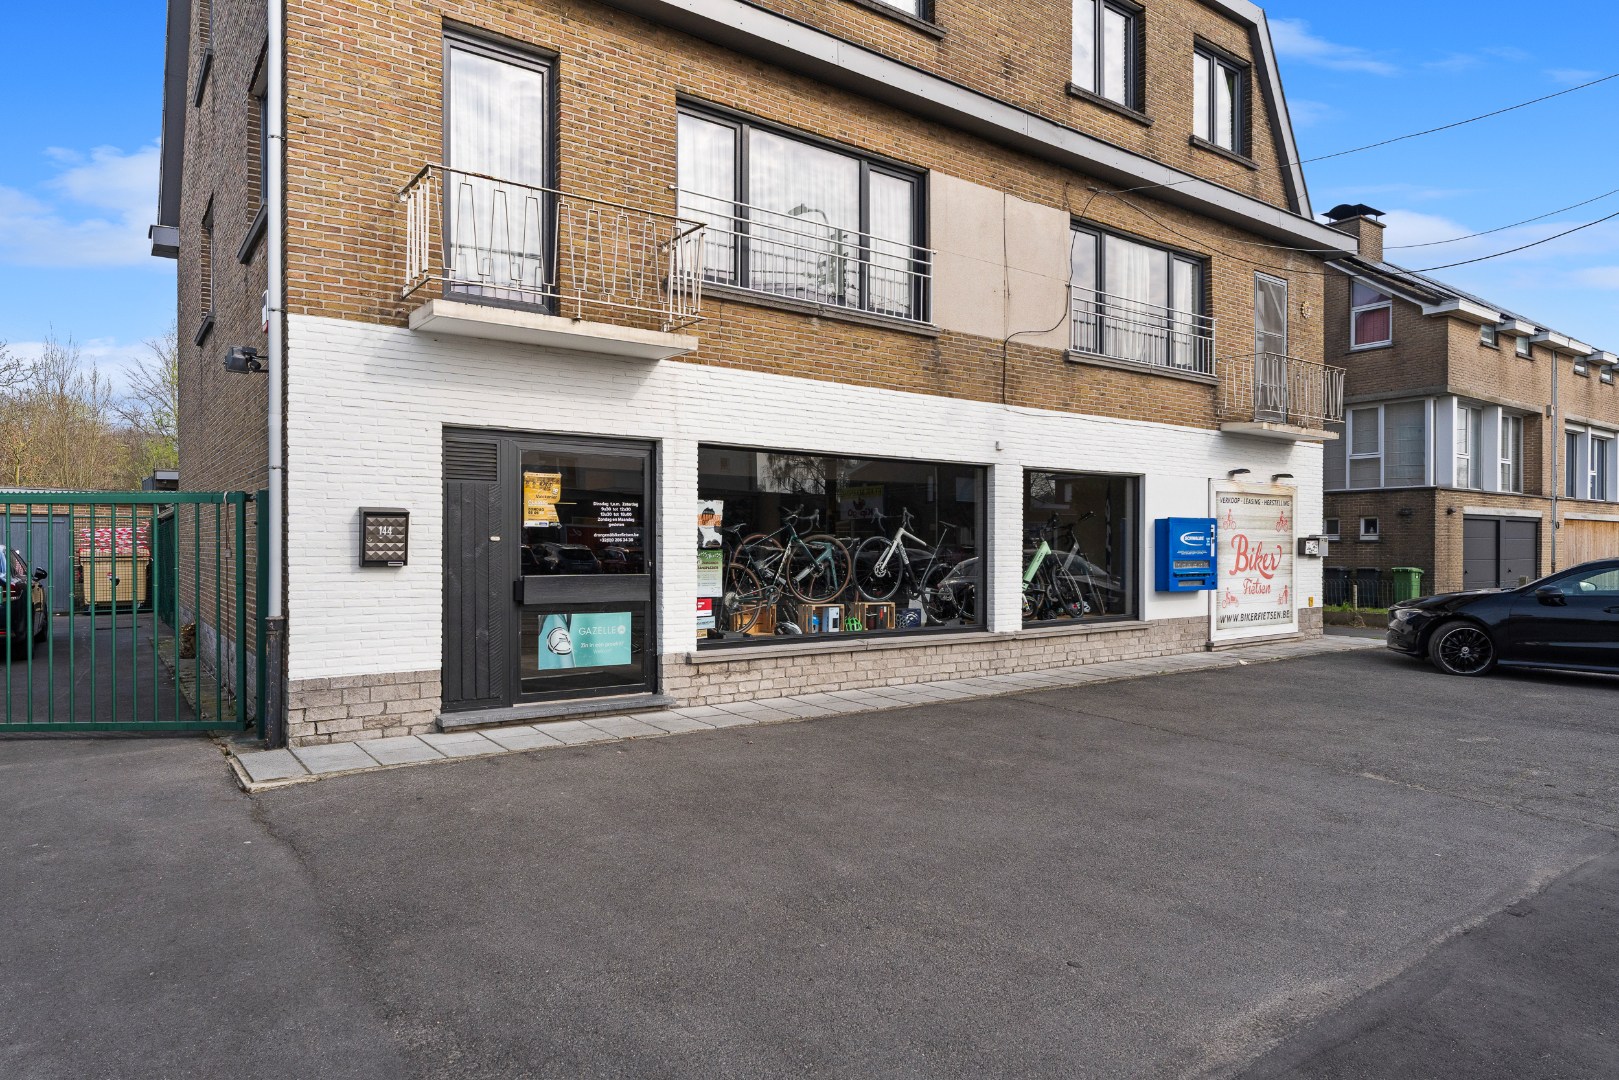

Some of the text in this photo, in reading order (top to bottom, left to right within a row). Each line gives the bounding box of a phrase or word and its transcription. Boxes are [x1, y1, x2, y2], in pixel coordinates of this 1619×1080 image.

[378, 526, 392, 536] 144
[1229, 534, 1282, 580] Biker
[1243, 578, 1271, 594] Fietsen
[1220, 610, 1290, 623] WWW.BIKERFIETSEN.BE
[578, 626, 616, 636] GAZELLE
